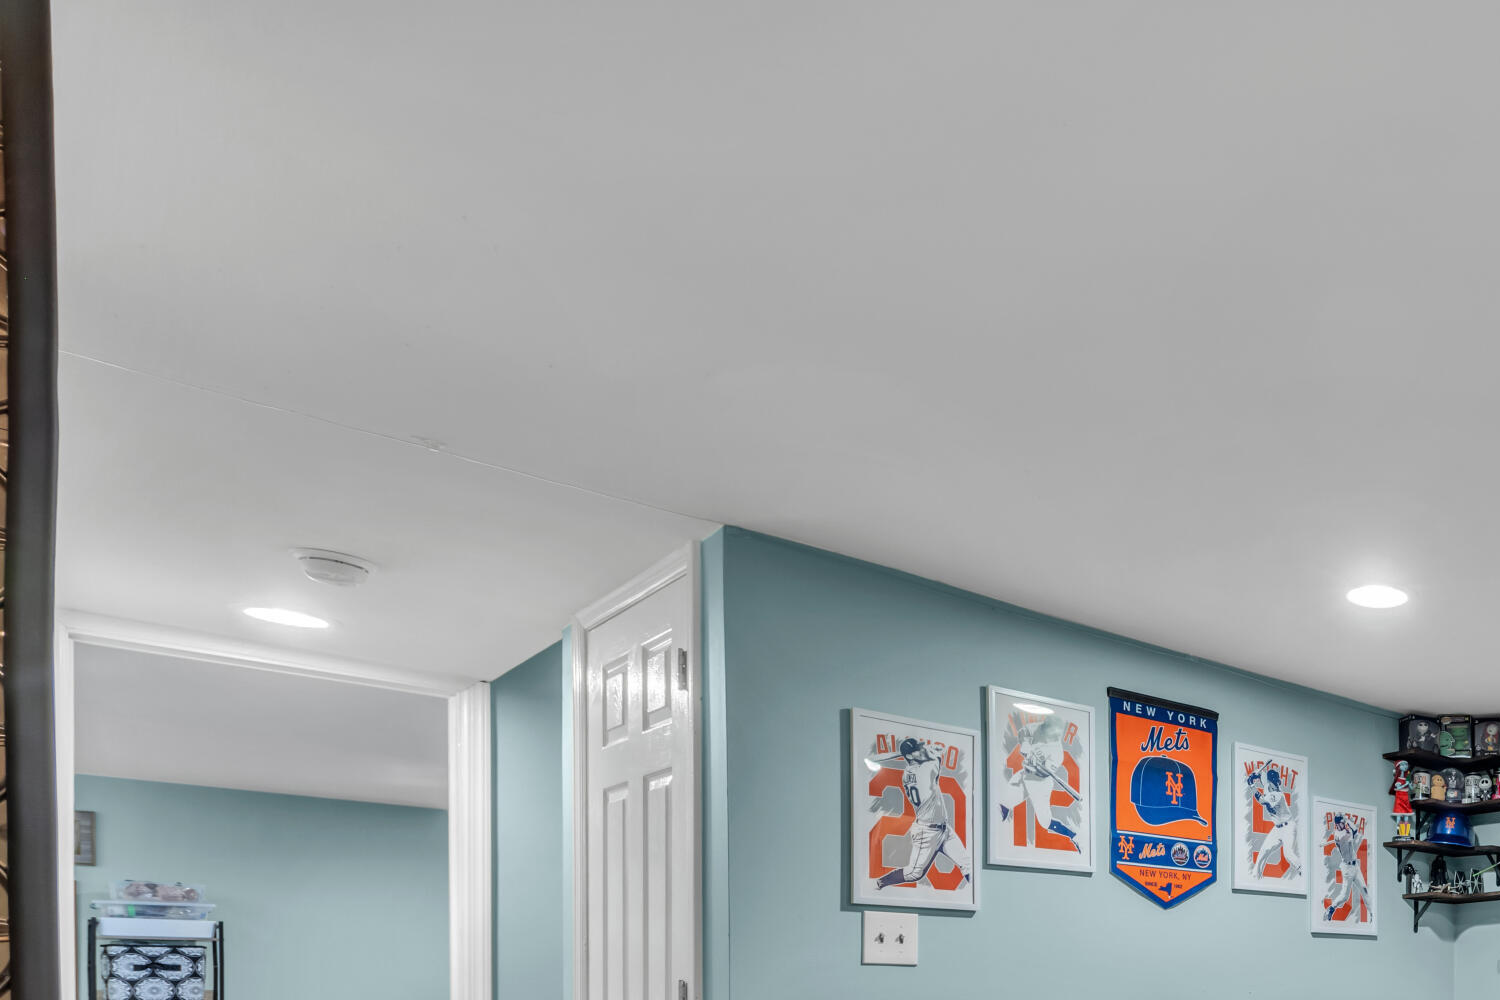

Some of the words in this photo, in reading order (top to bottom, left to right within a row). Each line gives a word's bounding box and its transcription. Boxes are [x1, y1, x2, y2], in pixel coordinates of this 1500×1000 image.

[1123, 701, 1156, 717] NEW
[1167, 710, 1207, 729] YORK
[876, 733, 959, 770] ALO
[1140, 725, 1190, 753] Mets
[1244, 760, 1298, 790] WHT
[1325, 812, 1367, 835] PZZA
[1139, 842, 1166, 859] Mets
[1140, 869, 1156, 877] NEW
[1182, 873, 1192, 881] NY
